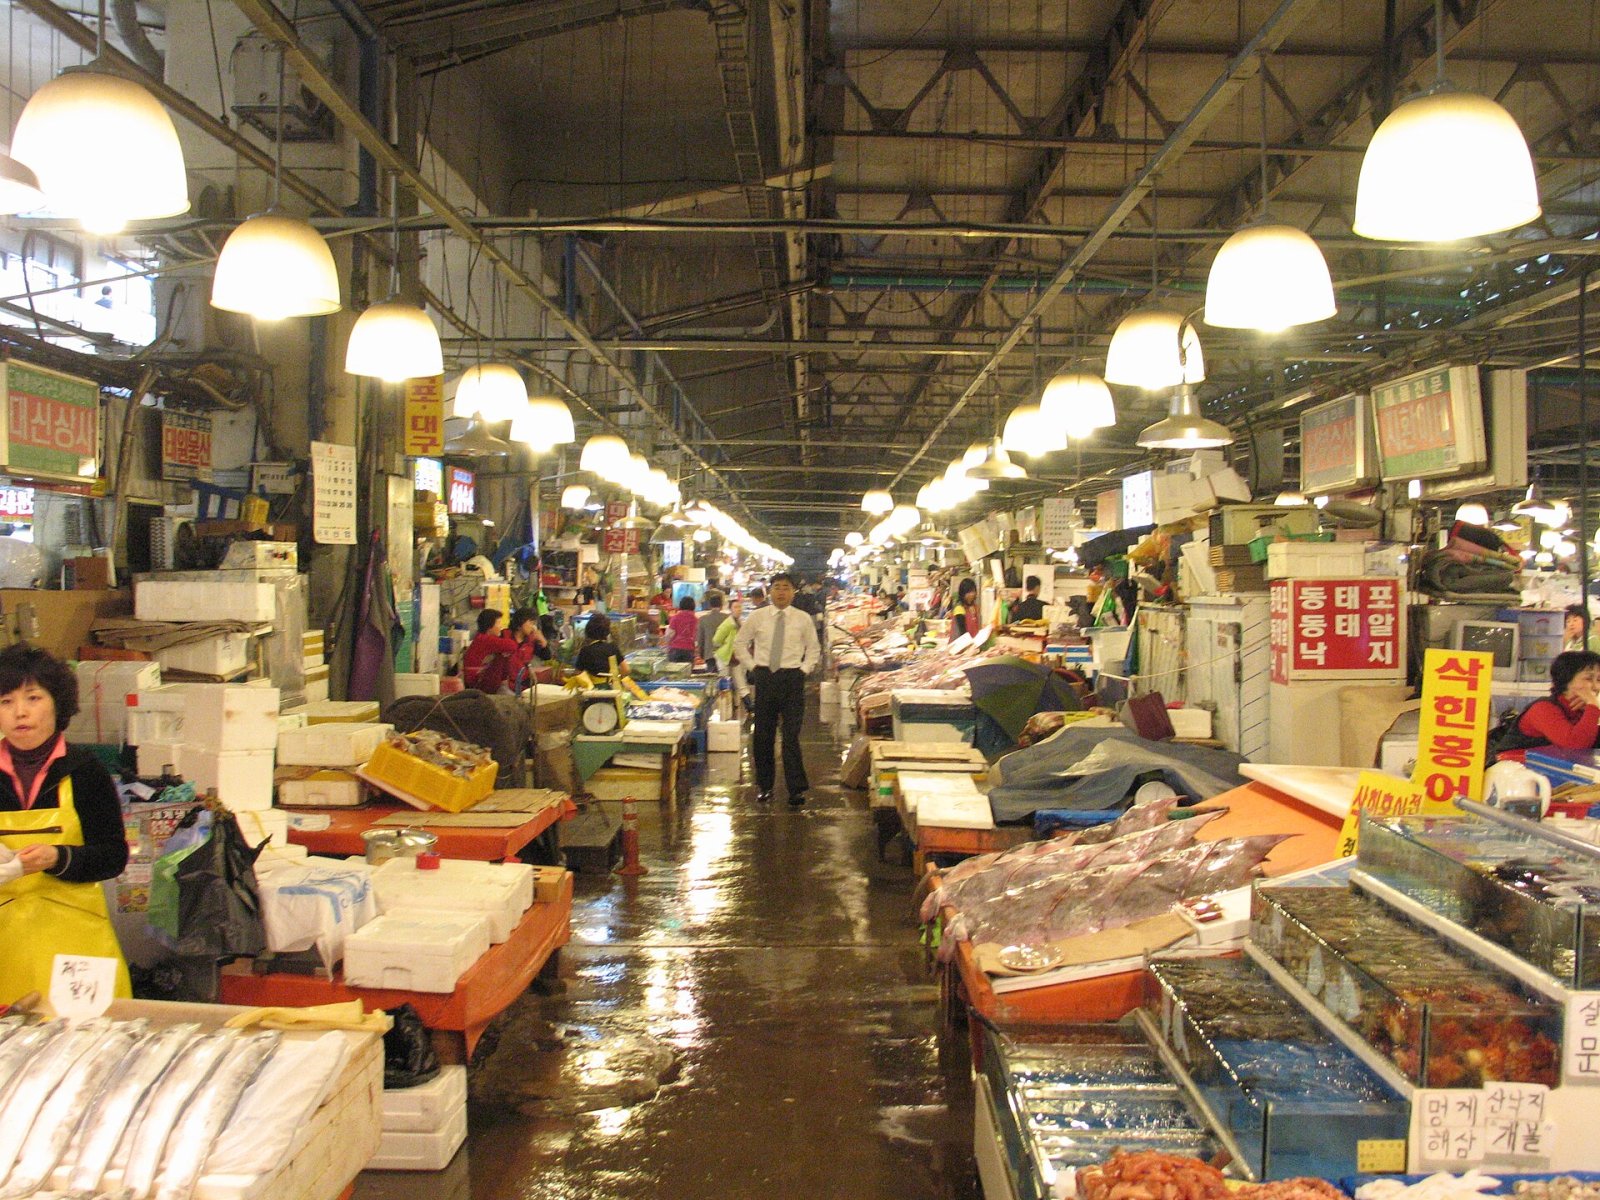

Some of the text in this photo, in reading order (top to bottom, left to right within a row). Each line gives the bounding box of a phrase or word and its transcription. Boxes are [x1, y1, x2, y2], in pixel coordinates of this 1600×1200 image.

[9, 395, 95, 456] 대신상사
[1298, 586, 1395, 610] 동태포
[1298, 613, 1395, 637] 동태알
[1300, 641, 1393, 666] 낙지
[1424, 657, 1485, 803] 삭힌홍어
[1428, 1094, 1478, 1127] 멍게
[1487, 1088, 1545, 1118] 산낙지
[1428, 1128, 1477, 1159] 해삼
[1492, 1120, 1542, 1153] 개불
